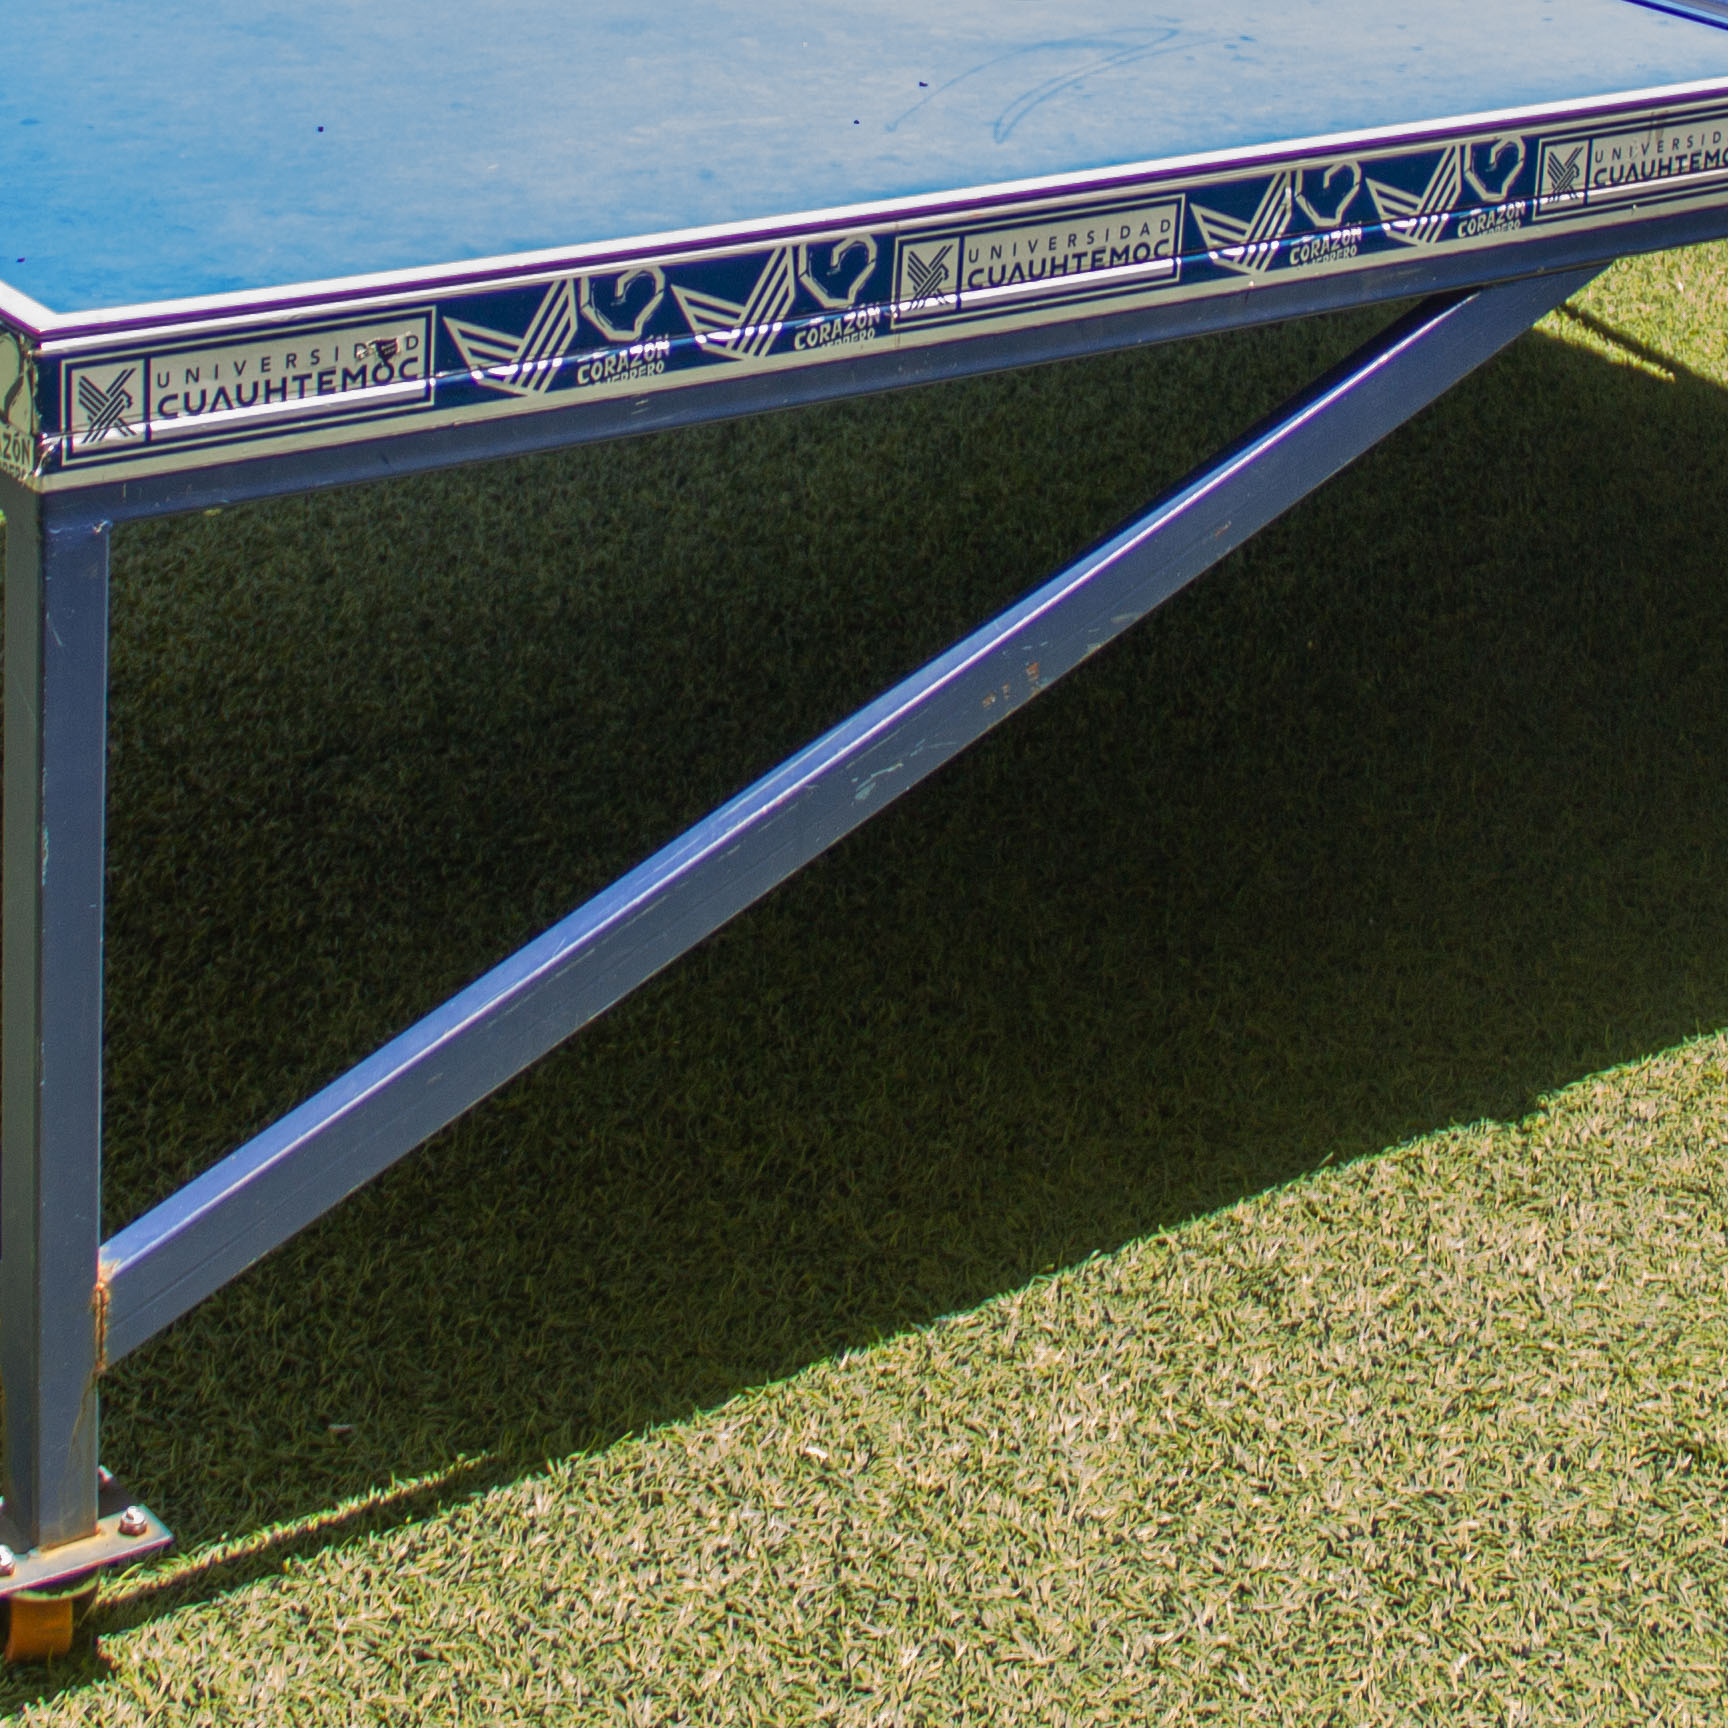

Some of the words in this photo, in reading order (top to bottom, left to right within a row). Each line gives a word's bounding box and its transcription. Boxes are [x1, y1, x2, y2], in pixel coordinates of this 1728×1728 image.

[967, 238, 1170, 290] CUAUHTEMOC
[968, 219, 1171, 263] UNIVERSIDAD
[156, 334, 420, 389] UNIVERSIDD
[157, 356, 420, 418] CUAUHTEMOC
